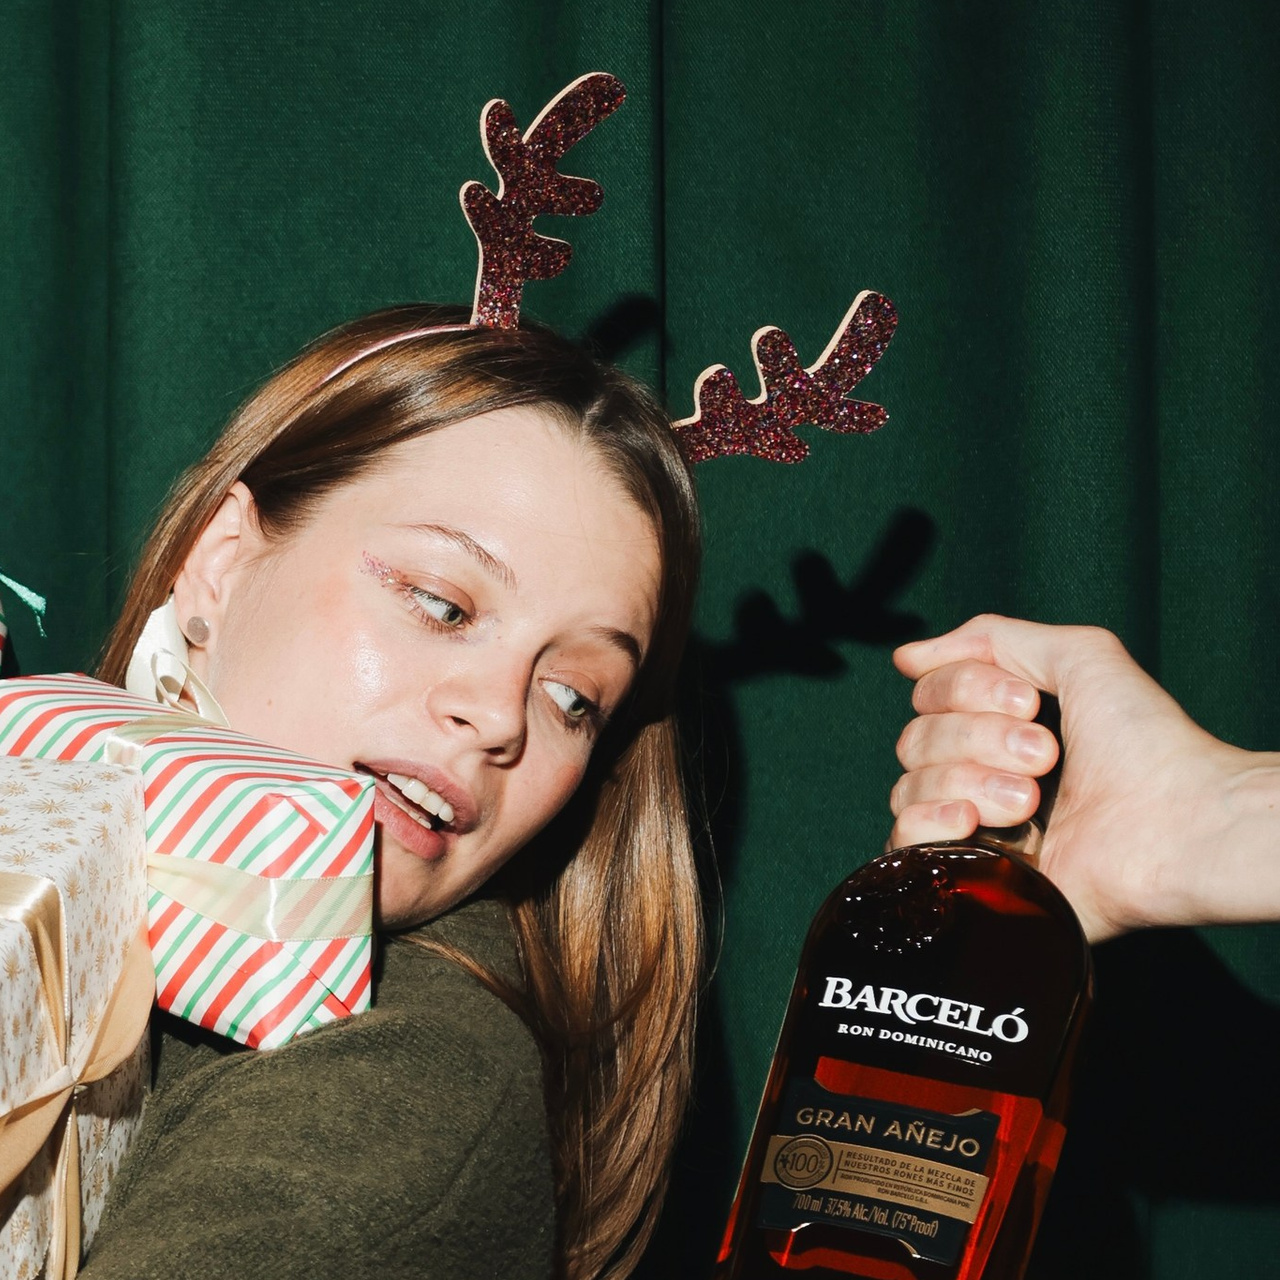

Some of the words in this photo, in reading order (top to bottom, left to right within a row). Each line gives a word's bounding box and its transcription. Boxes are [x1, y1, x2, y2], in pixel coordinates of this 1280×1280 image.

[818, 976, 1029, 1043] BARCELÓ
[838, 1023, 875, 1037] RON
[878, 1029, 993, 1062] DOMINICANO
[796, 1107, 876, 1134] GRAN
[883, 1120, 981, 1157] AÑEJO
[843, 1160, 891, 1176] NUESTROS
[893, 1169, 924, 1182] RONES
[926, 1176, 945, 1188] MÁS
[947, 1182, 976, 1197] FINOS
[846, 1151, 897, 1167] RESULTADO
[899, 1161, 912, 1170] DE
[914, 1164, 925, 1173] LA
[927, 1168, 962, 1184] MEZCLA
[964, 1178, 977, 1188] DE
[825, 1197, 852, 1218] 37,5%
